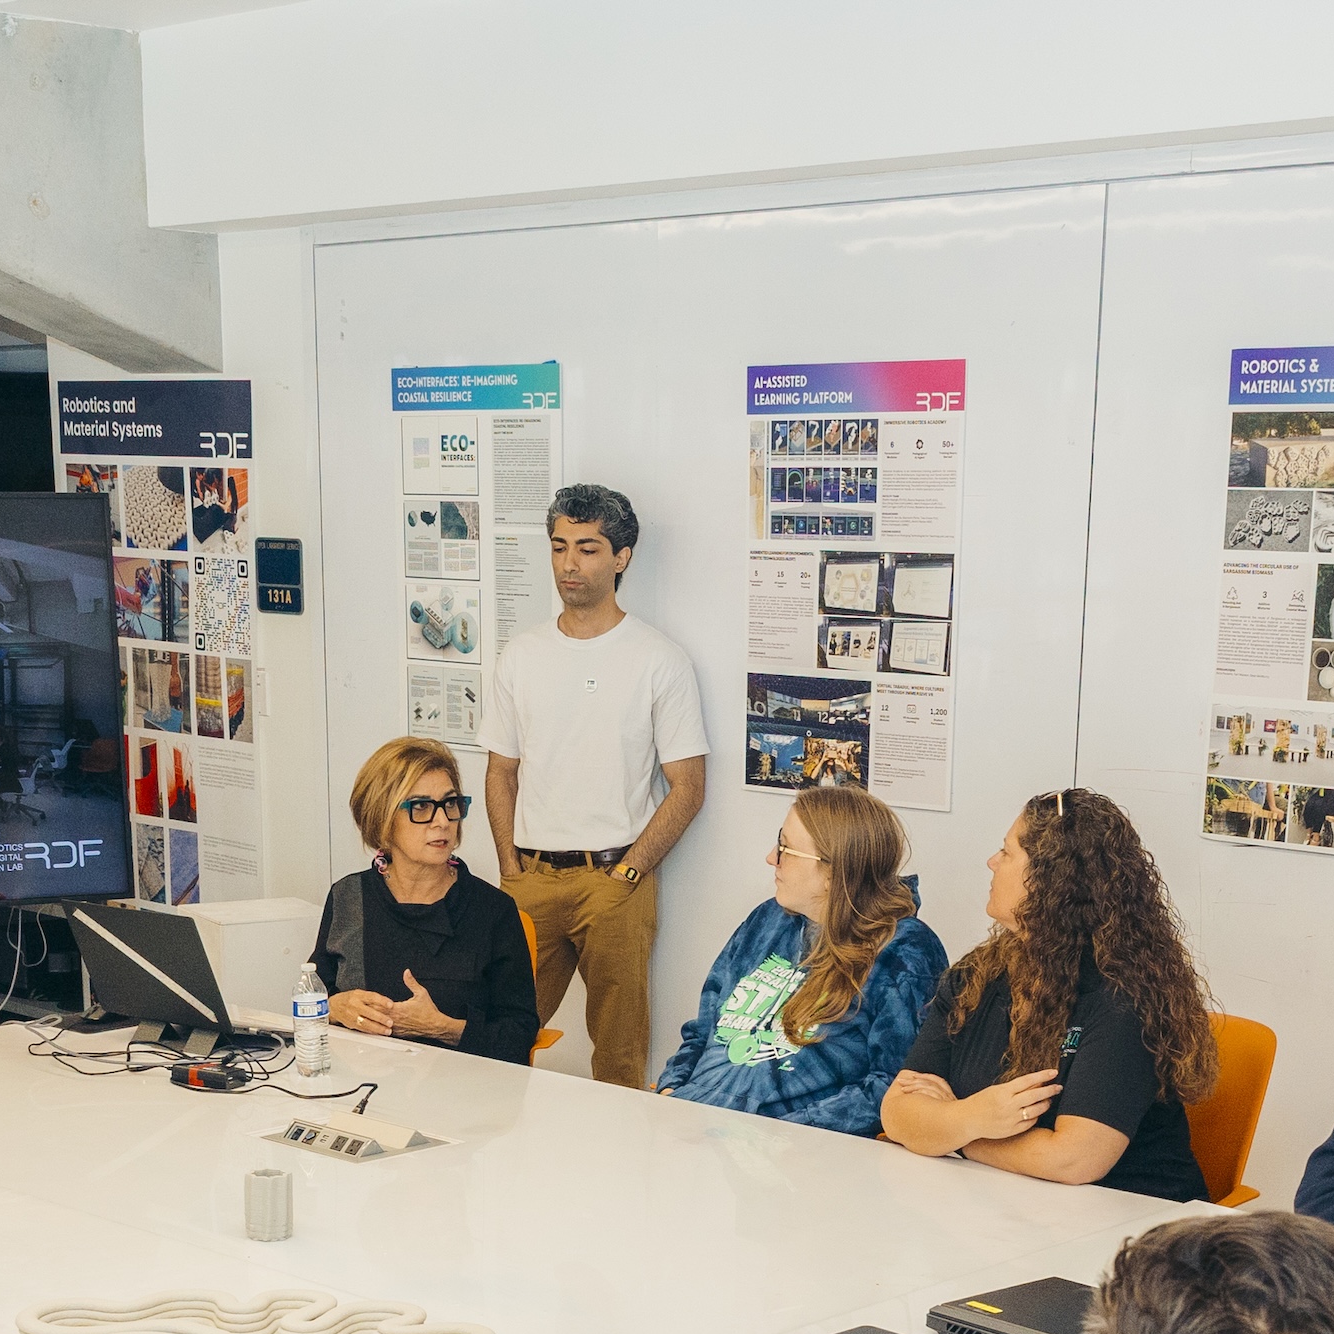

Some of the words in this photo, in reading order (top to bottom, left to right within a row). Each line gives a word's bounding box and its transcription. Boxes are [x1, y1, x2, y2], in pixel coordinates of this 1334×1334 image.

[1241, 359, 1306, 375] ROBOTICS
[1309, 359, 1320, 373] &
[397, 376, 460, 388] ECO-INTERFACES:
[462, 375, 518, 386] RE-IMAGINING
[754, 375, 808, 389] AI-ASSISTED
[1240, 380, 1297, 394] MATERIAL
[397, 392, 429, 403] COASTAL
[431, 391, 472, 402] RESILIENCE
[754, 393, 800, 405] LEARNING
[803, 392, 853, 404] PLATFORM
[63, 397, 110, 413] Robotics
[113, 397, 136, 413] and
[64, 420, 109, 436] Material
[112, 422, 163, 442] Systems
[441, 435, 475, 451] ECO-
[268, 589, 292, 603] 131A
[818, 712, 828, 723] 12
[930, 708, 947, 716] 1,200
[7, 863, 23, 871] LAB
